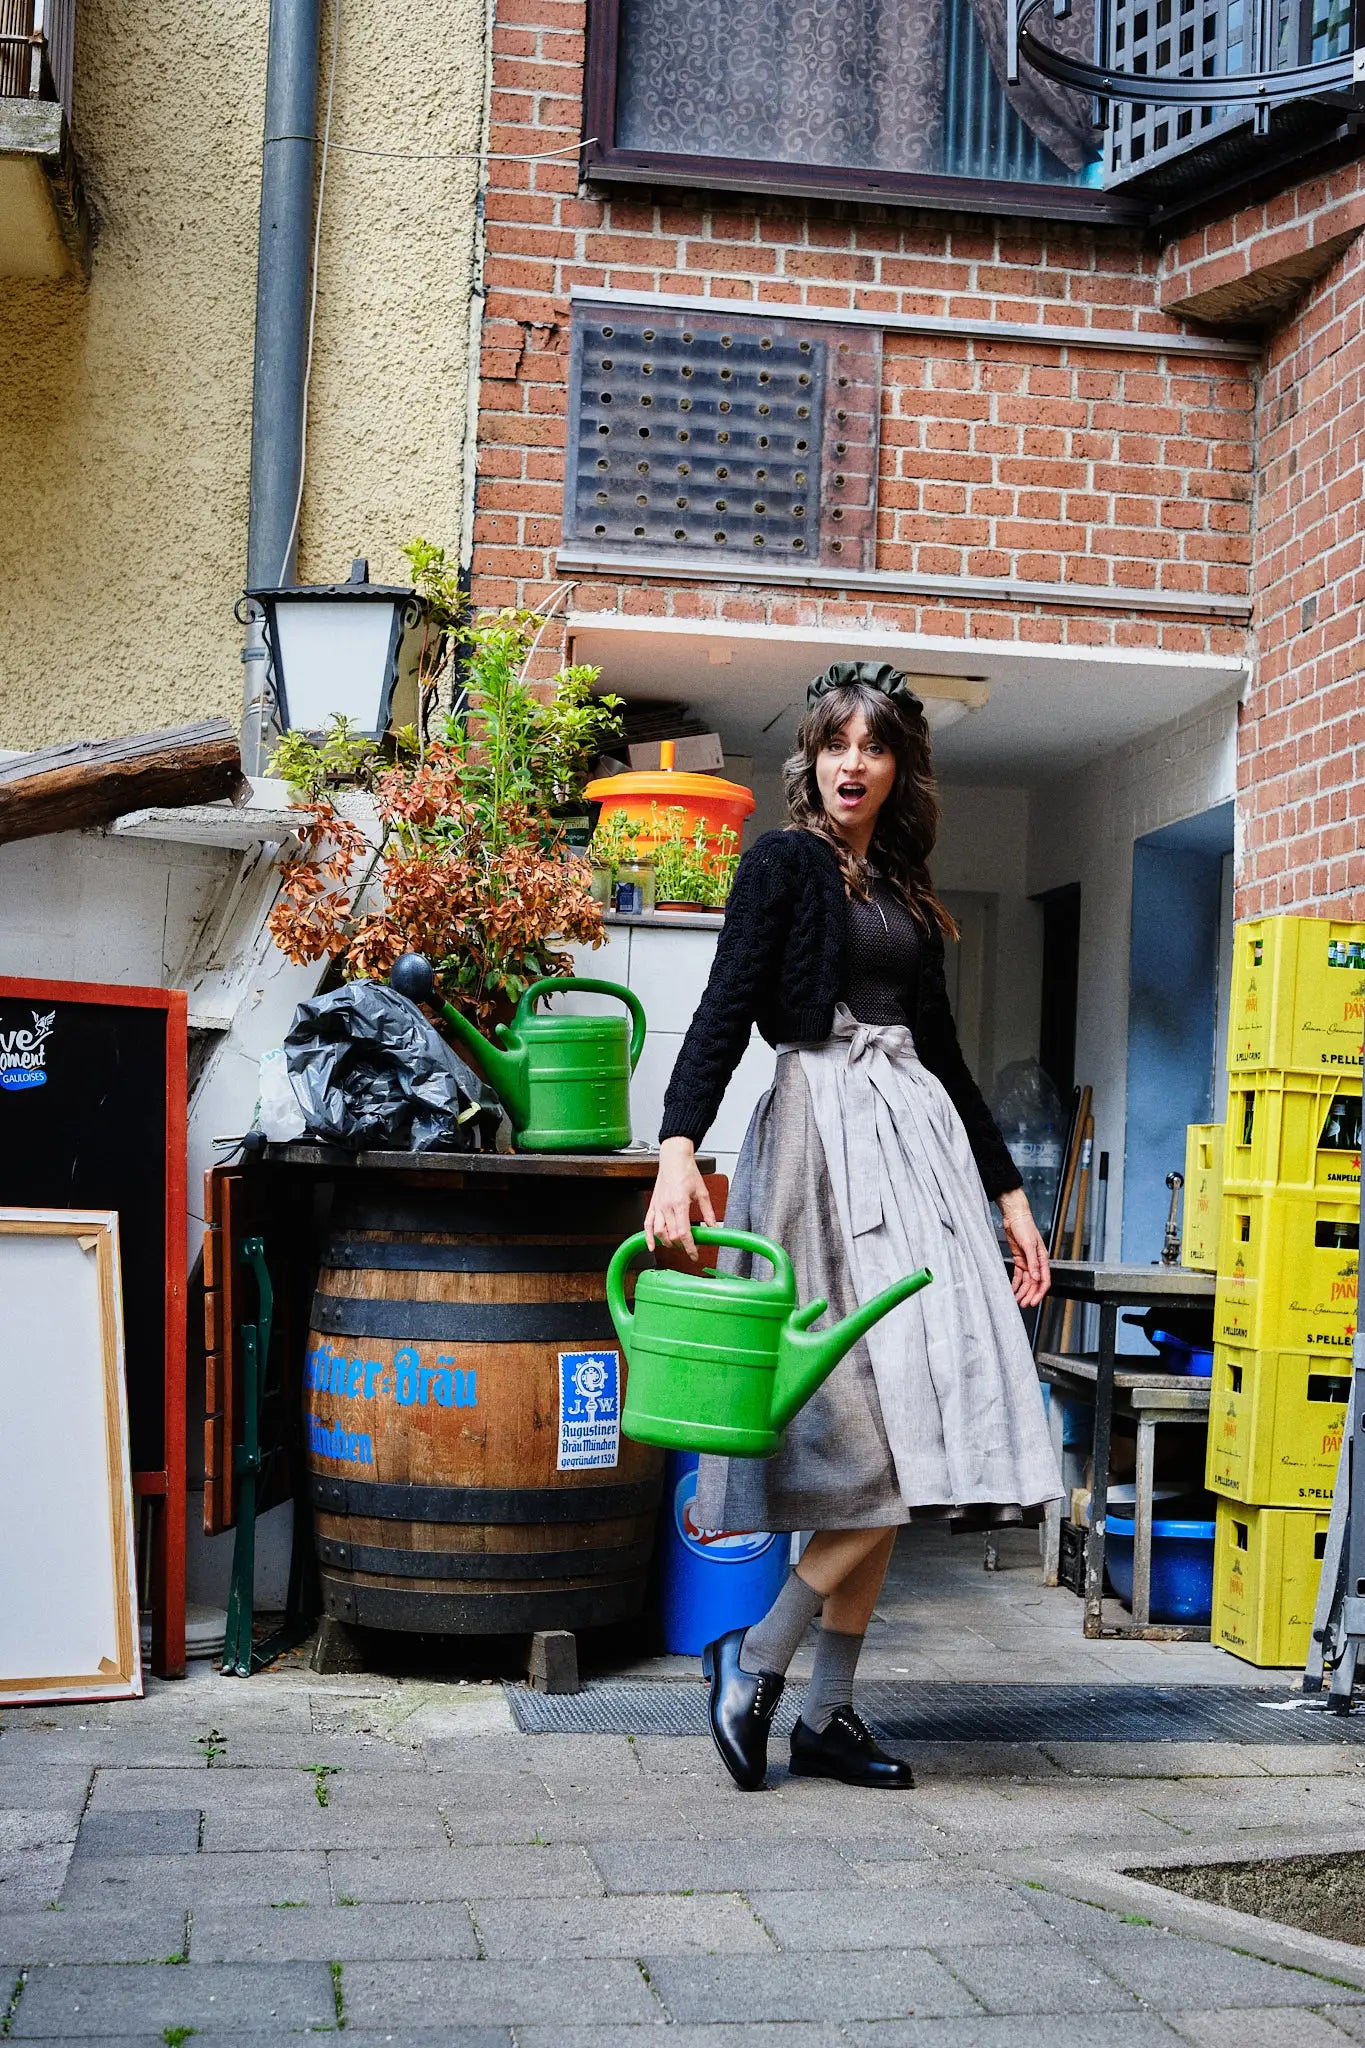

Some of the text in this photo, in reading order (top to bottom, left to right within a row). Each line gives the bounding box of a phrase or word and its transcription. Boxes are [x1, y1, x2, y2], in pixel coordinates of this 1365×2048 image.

[0, 1044, 46, 1070] oment
[2, 1071, 45, 1084] GAULOISES
[1307, 1333, 1354, 1347] S.PELLE
[562, 1438, 616, 1453] Bräu München
